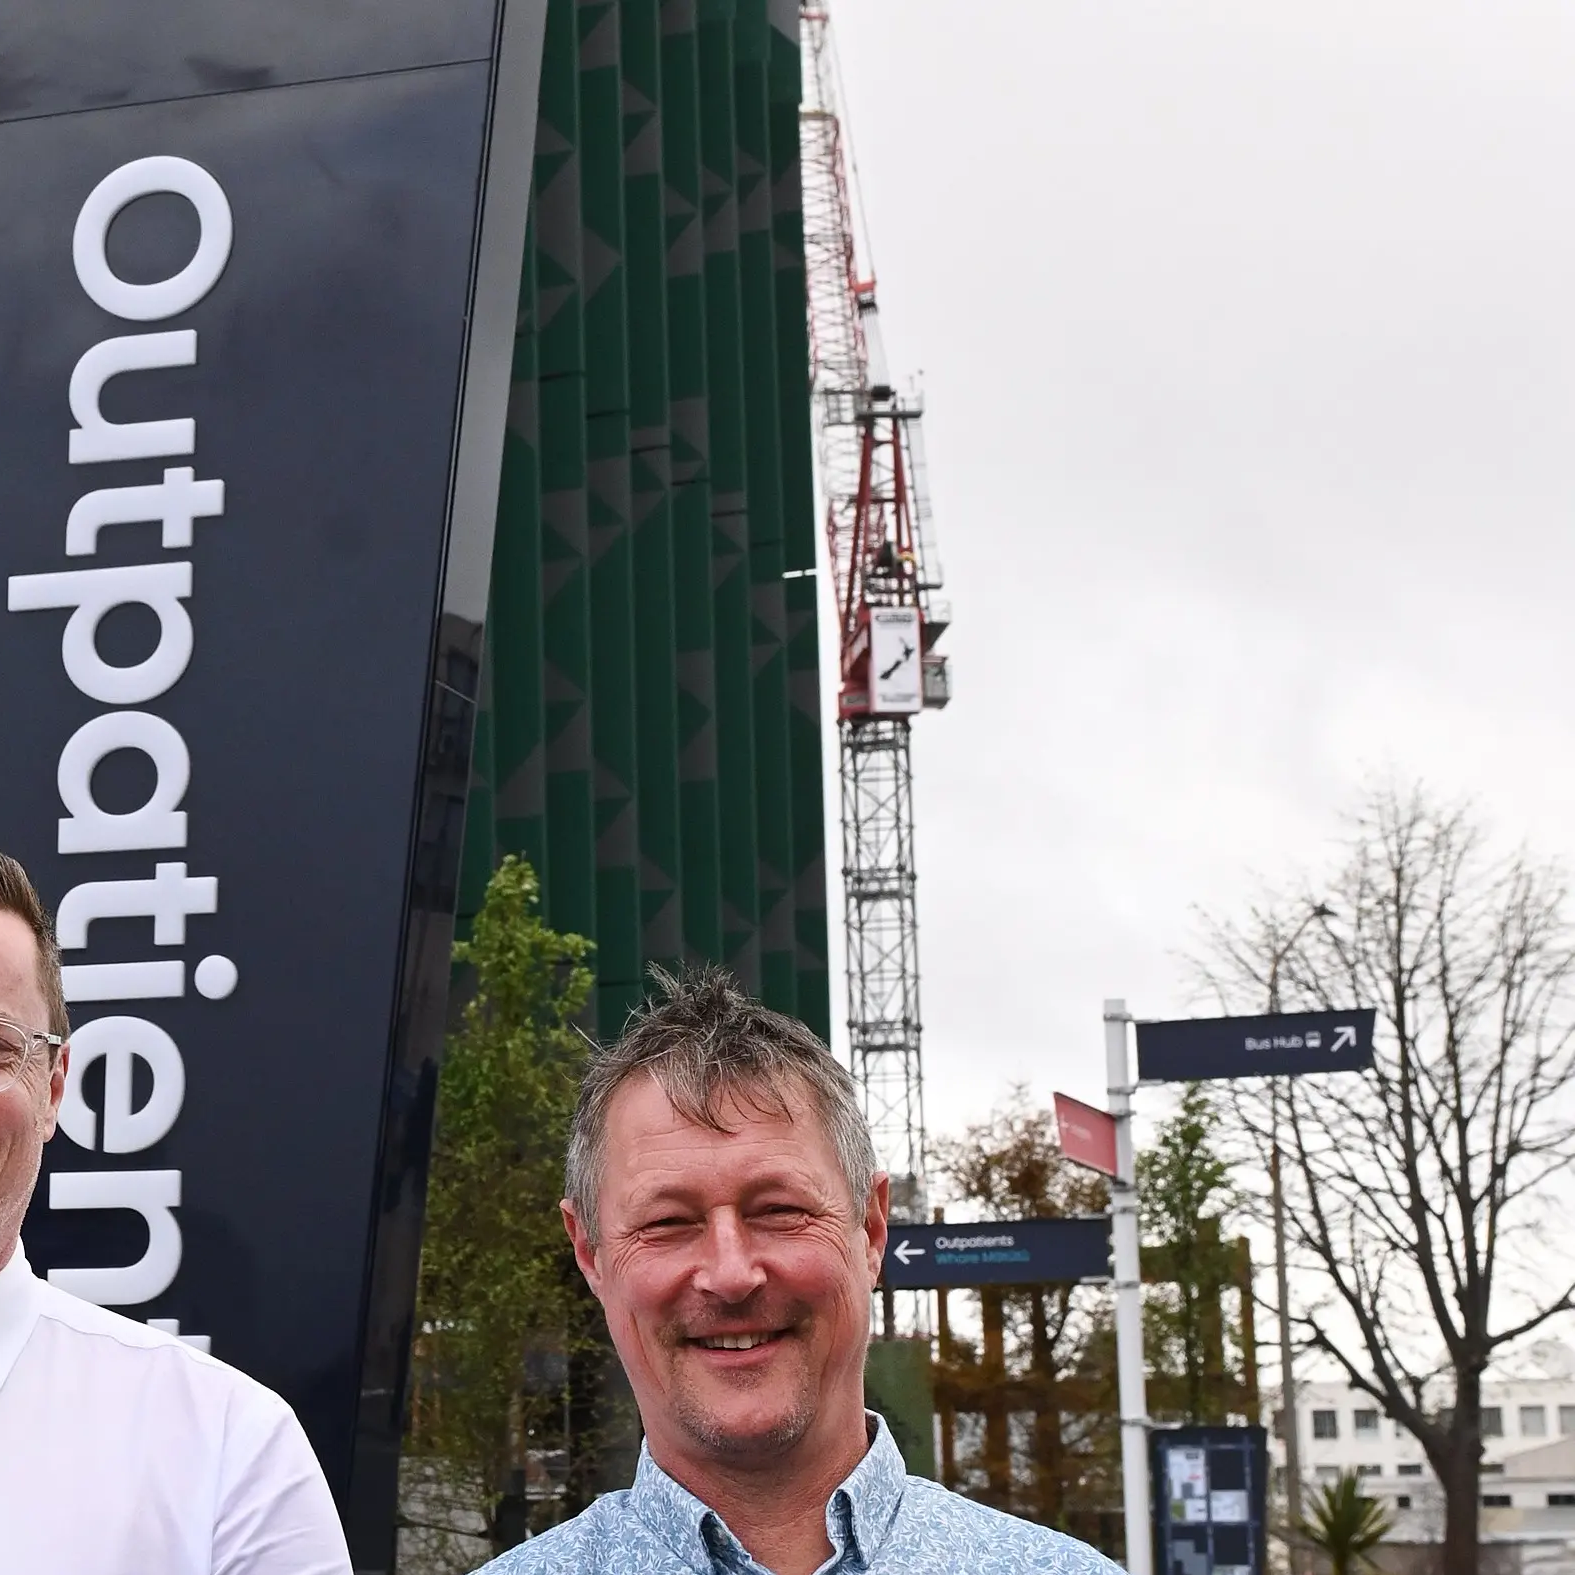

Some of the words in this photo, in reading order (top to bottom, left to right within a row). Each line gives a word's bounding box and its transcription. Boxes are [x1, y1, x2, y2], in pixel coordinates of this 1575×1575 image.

[8, 155, 239, 1354] Outpatien
[1245, 1037, 1271, 1051] Bus
[1273, 1034, 1304, 1049] Hub
[935, 1235, 1015, 1250] Outpatients
